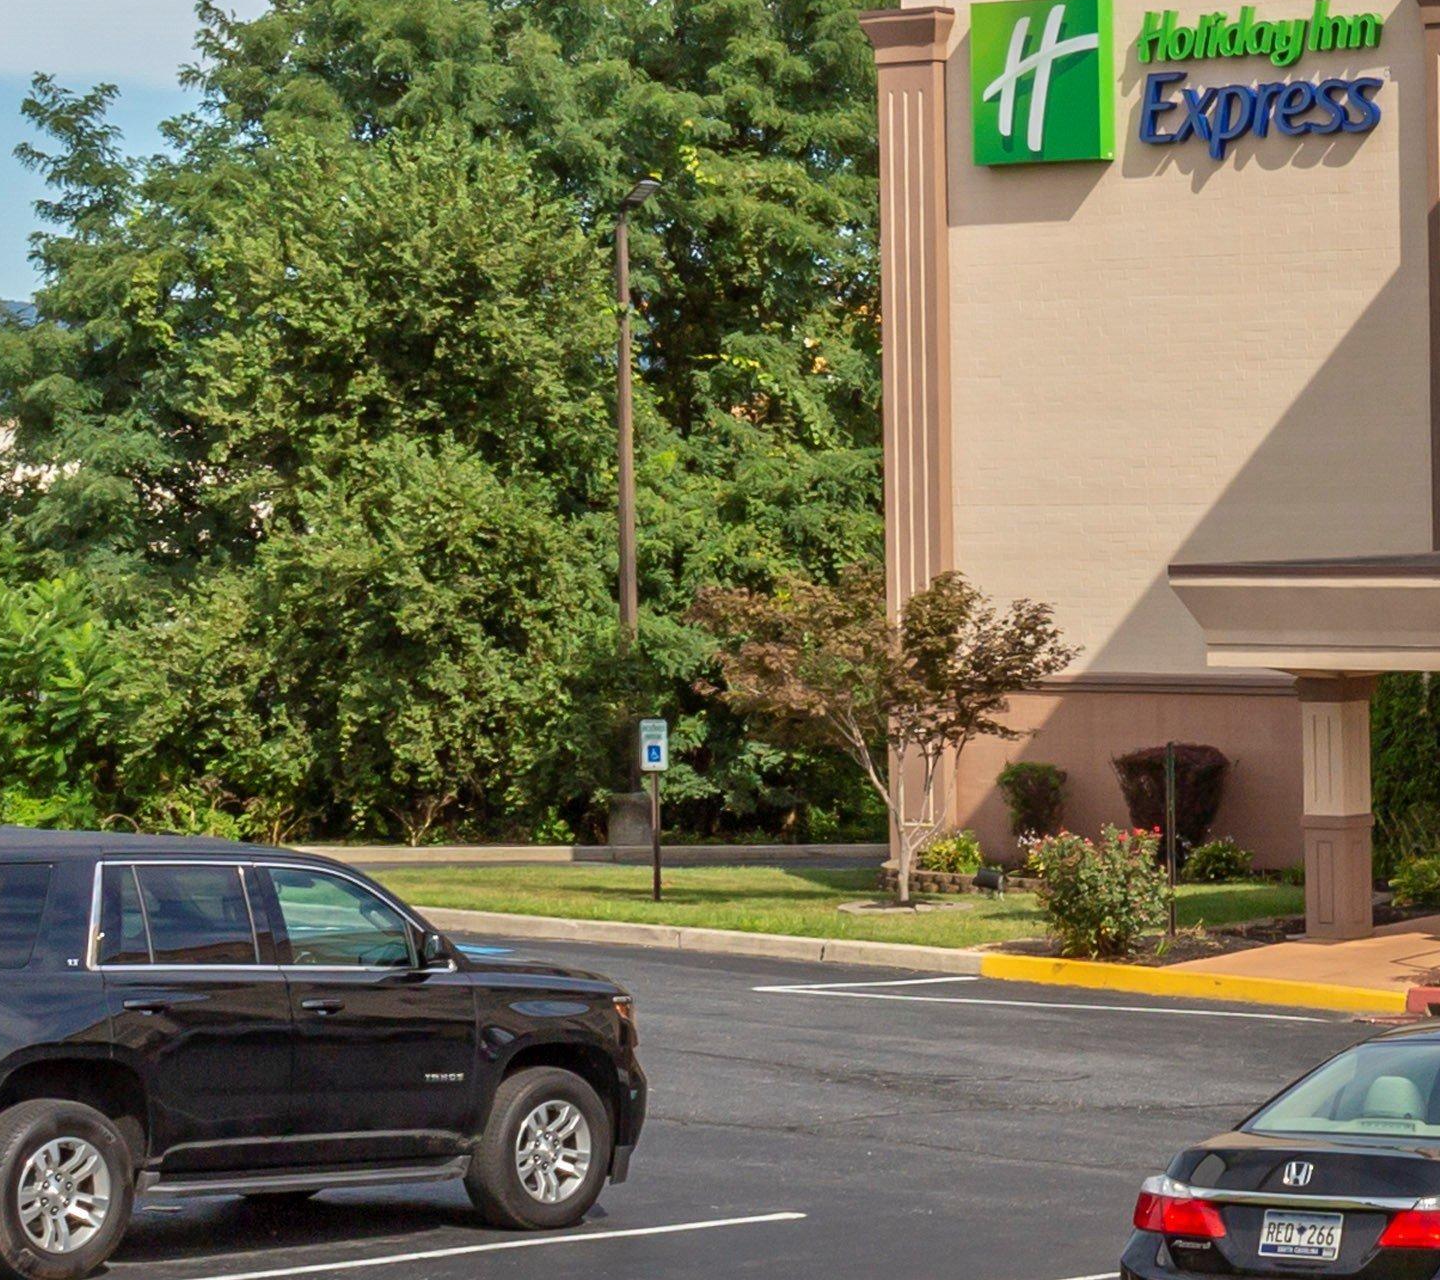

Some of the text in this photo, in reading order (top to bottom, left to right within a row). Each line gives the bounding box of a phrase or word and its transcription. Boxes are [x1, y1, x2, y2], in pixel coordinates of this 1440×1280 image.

[1137, 6, 1309, 67] Holiday
[1140, 72, 1384, 160] Express
[1307, 1223, 1335, 1246] 266
